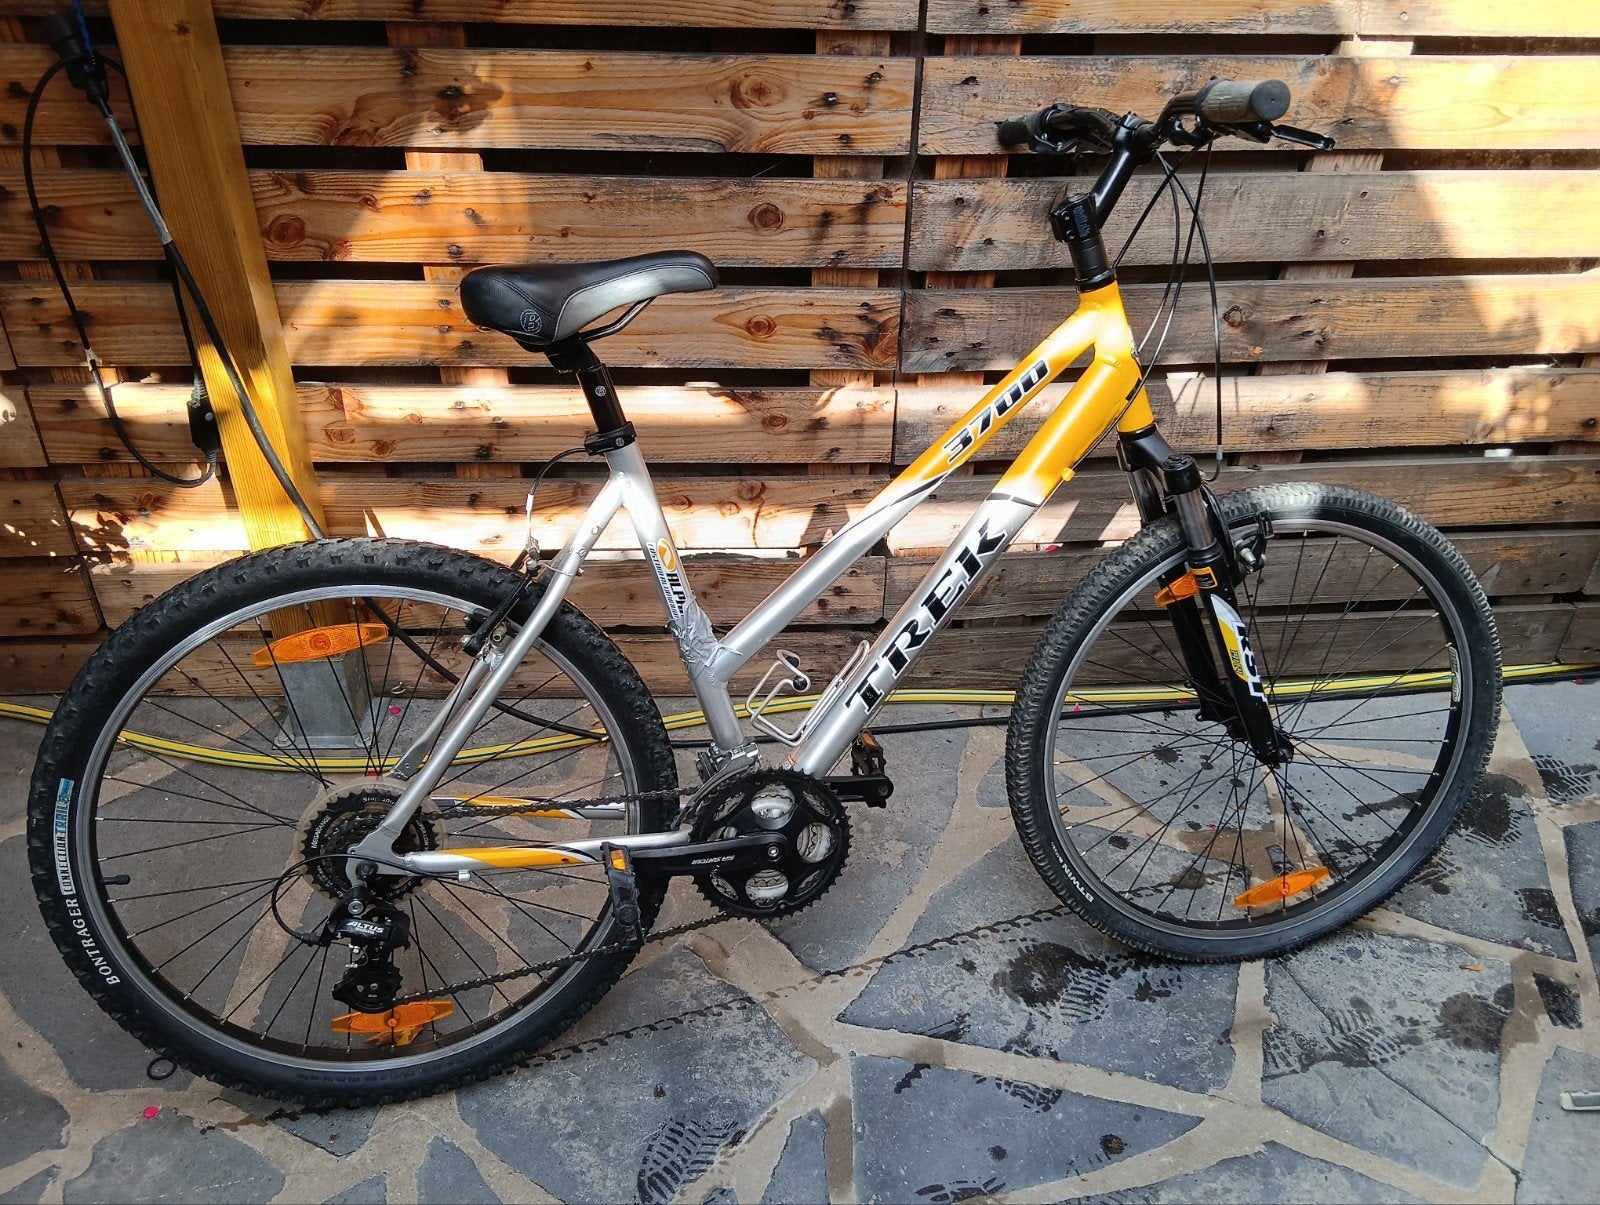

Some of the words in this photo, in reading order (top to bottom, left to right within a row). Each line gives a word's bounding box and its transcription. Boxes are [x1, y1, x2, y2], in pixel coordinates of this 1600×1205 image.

[942, 359, 1049, 464] 3700
[666, 572, 687, 617] ALPH
[845, 518, 1008, 715] TREK
[55, 803, 70, 833] TRAIL
[311, 814, 331, 849] MEGARANGE
[56, 833, 75, 895] CONNECTION
[65, 898, 121, 985] BONTRAGER
[346, 921, 384, 933] ALTUS
